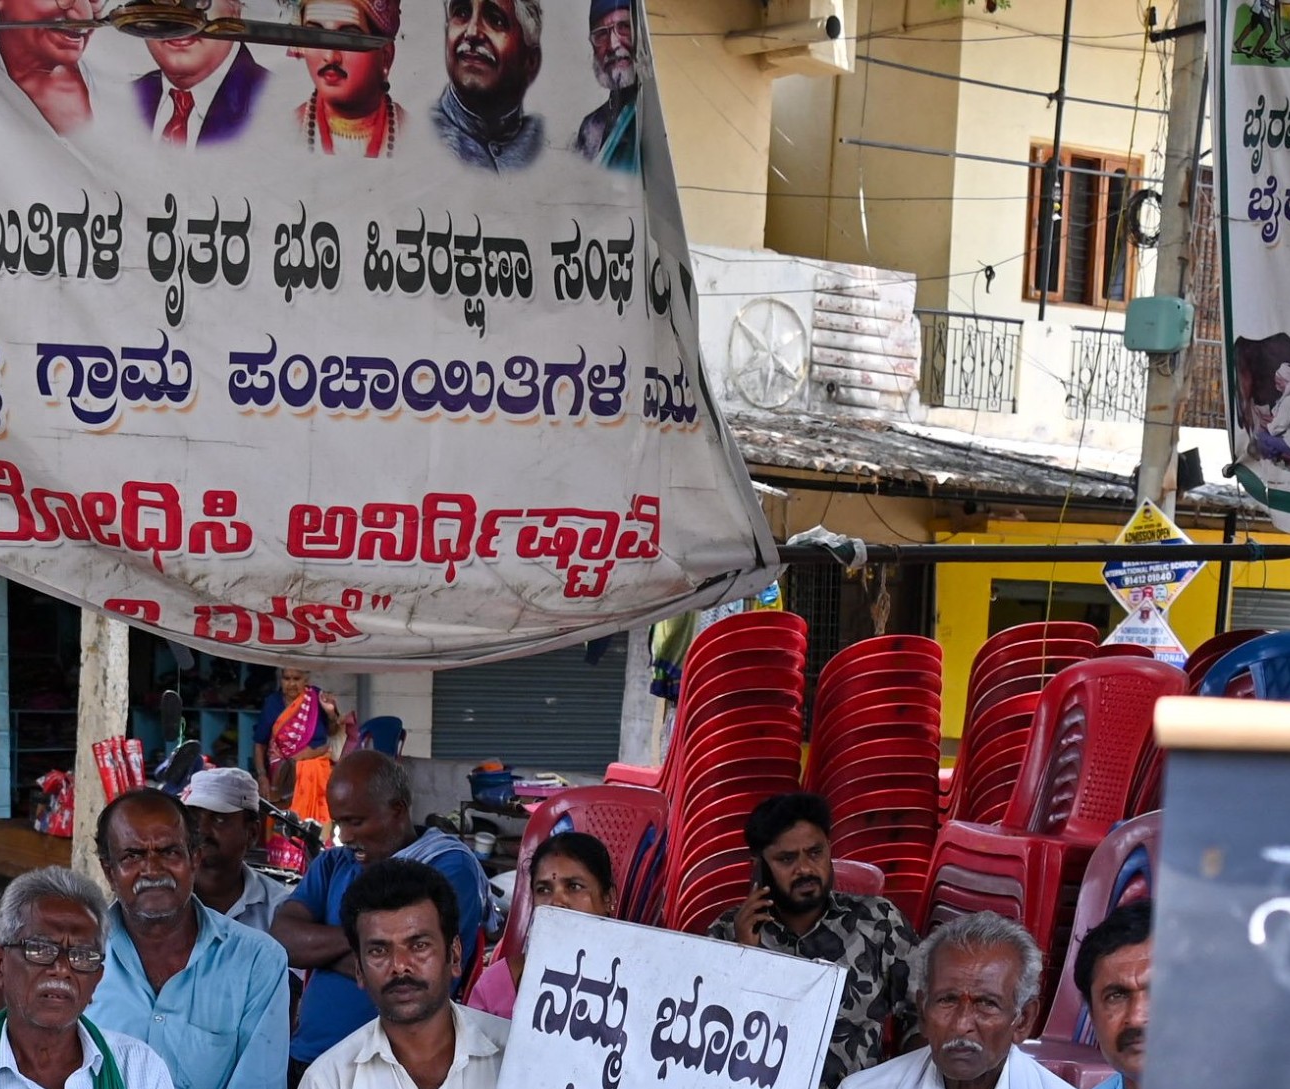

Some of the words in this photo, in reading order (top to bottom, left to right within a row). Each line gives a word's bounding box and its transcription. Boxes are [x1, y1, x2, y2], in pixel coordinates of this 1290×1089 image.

[147, 193, 251, 327] ರೈತರ
[274, 200, 340, 303] ಭೂ
[364, 207, 534, 338] ಹಿತರಕ್ಷಣಾ
[551, 217, 635, 316] ಸಂಘ
[37, 328, 192, 424] ಗ್ರಾಮ
[228, 333, 626, 418] ಪಂಚಾಯಿತಿಗಳ
[650, 975, 788, 1089] ಭೂಮಿ
